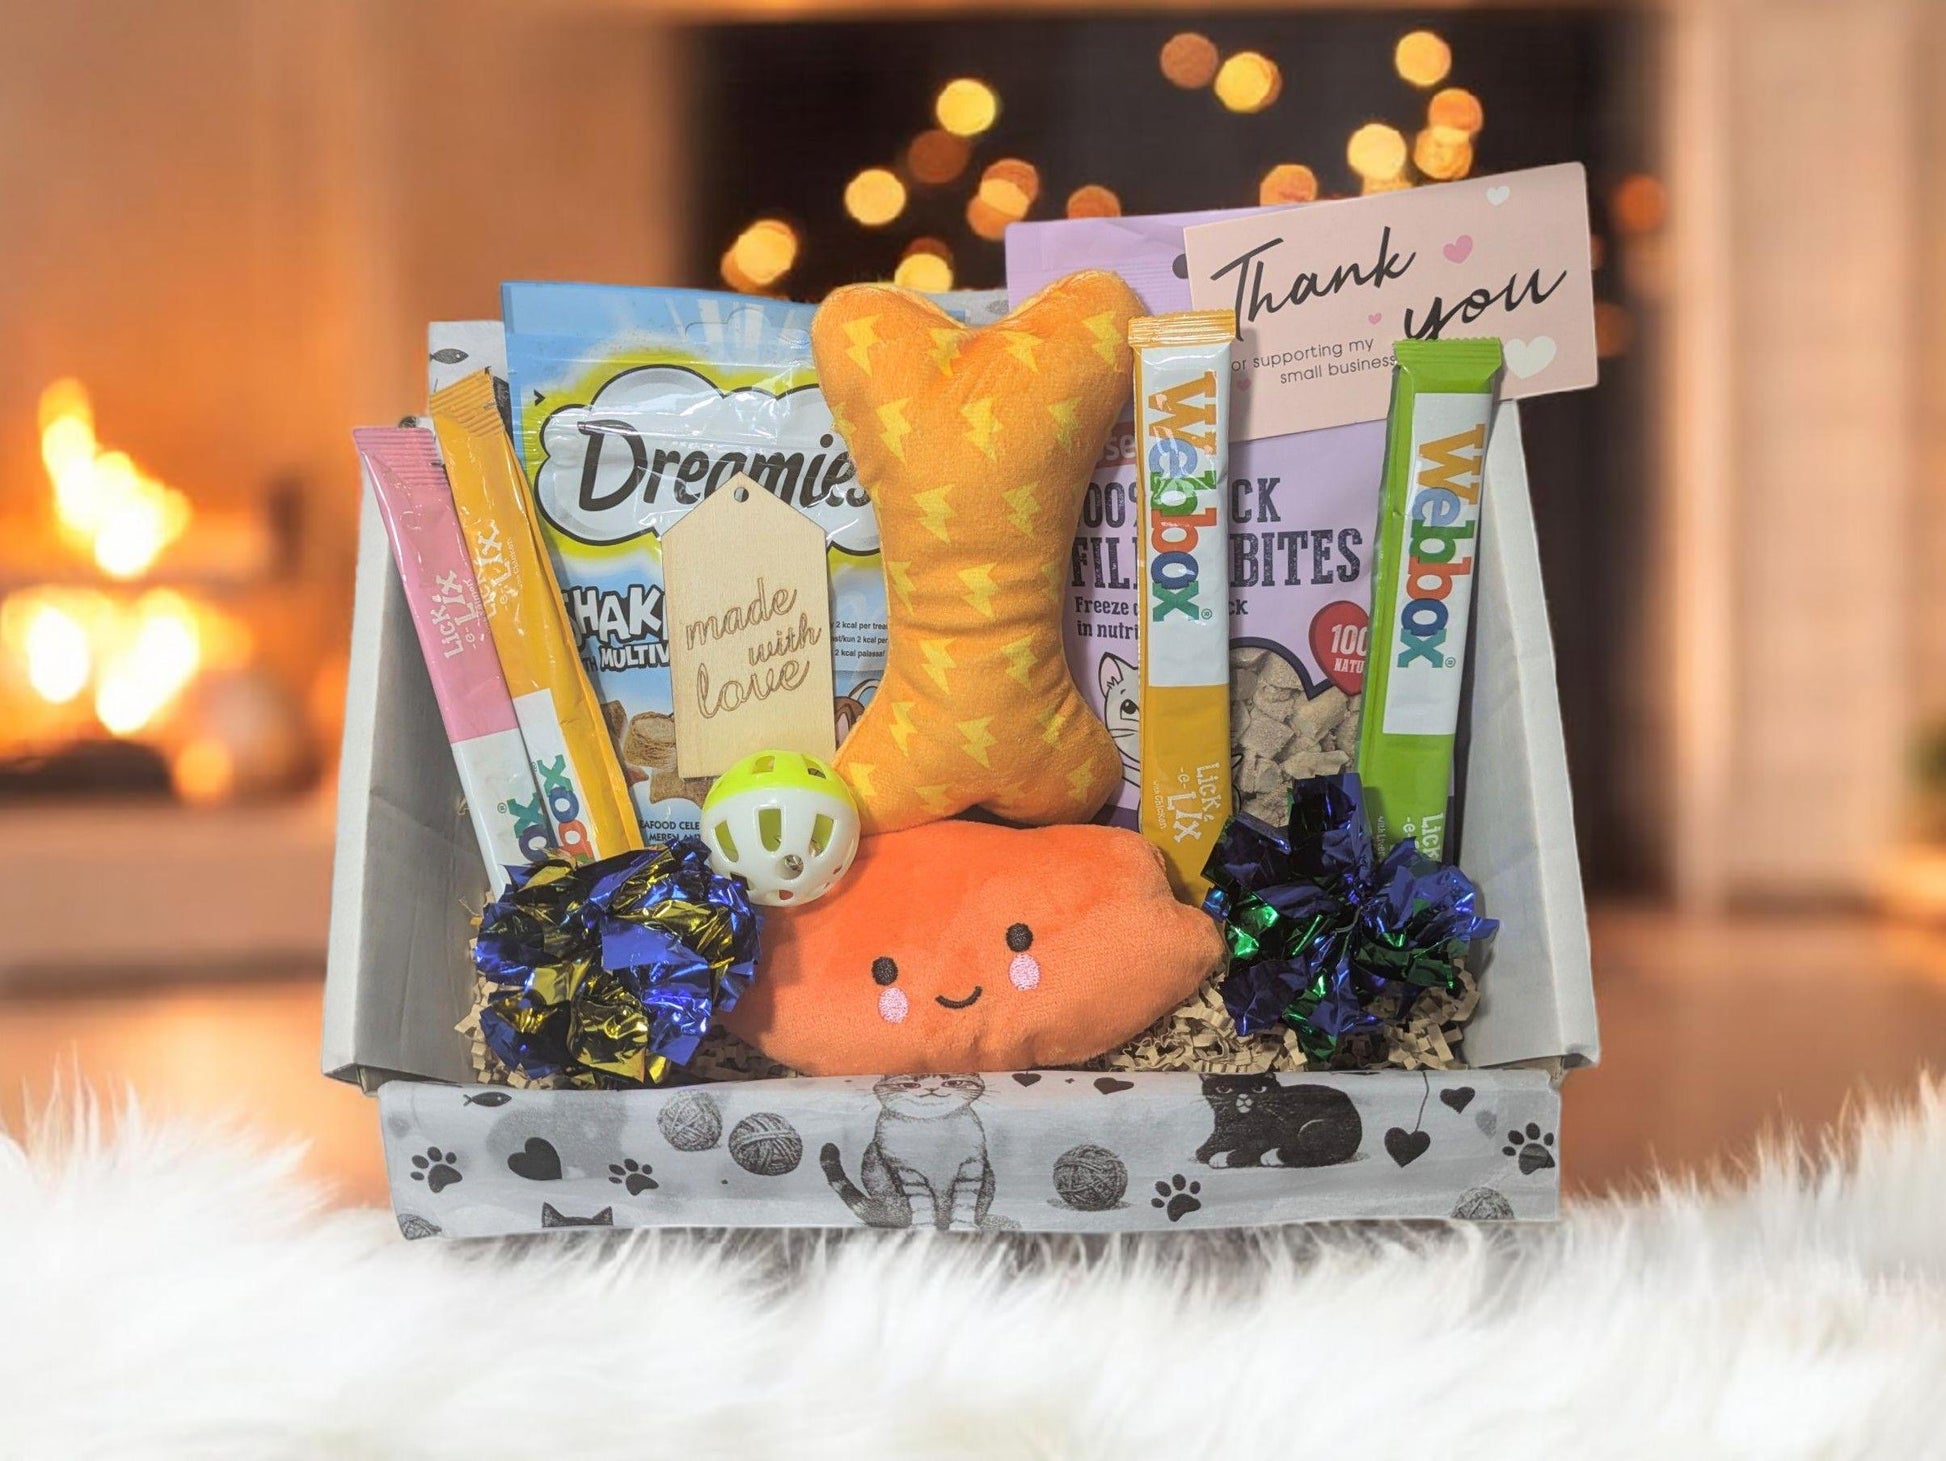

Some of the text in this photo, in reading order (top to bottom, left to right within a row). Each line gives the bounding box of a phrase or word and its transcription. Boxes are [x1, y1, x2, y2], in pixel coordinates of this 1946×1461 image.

[1210, 225, 1416, 342] Thank
[1403, 268, 1567, 340] you
[1231, 337, 1374, 372] or supporting my
[1280, 354, 1397, 385] small business
[1229, 527, 1363, 588] BITES
[685, 576, 798, 651] made
[1074, 596, 1130, 615] Freeze
[748, 612, 822, 667] with
[842, 621, 857, 629] kcal
[857, 635, 862, 643] 2
[1077, 620, 1093, 637] in
[841, 649, 856, 657] kcal
[696, 662, 811, 719] love
